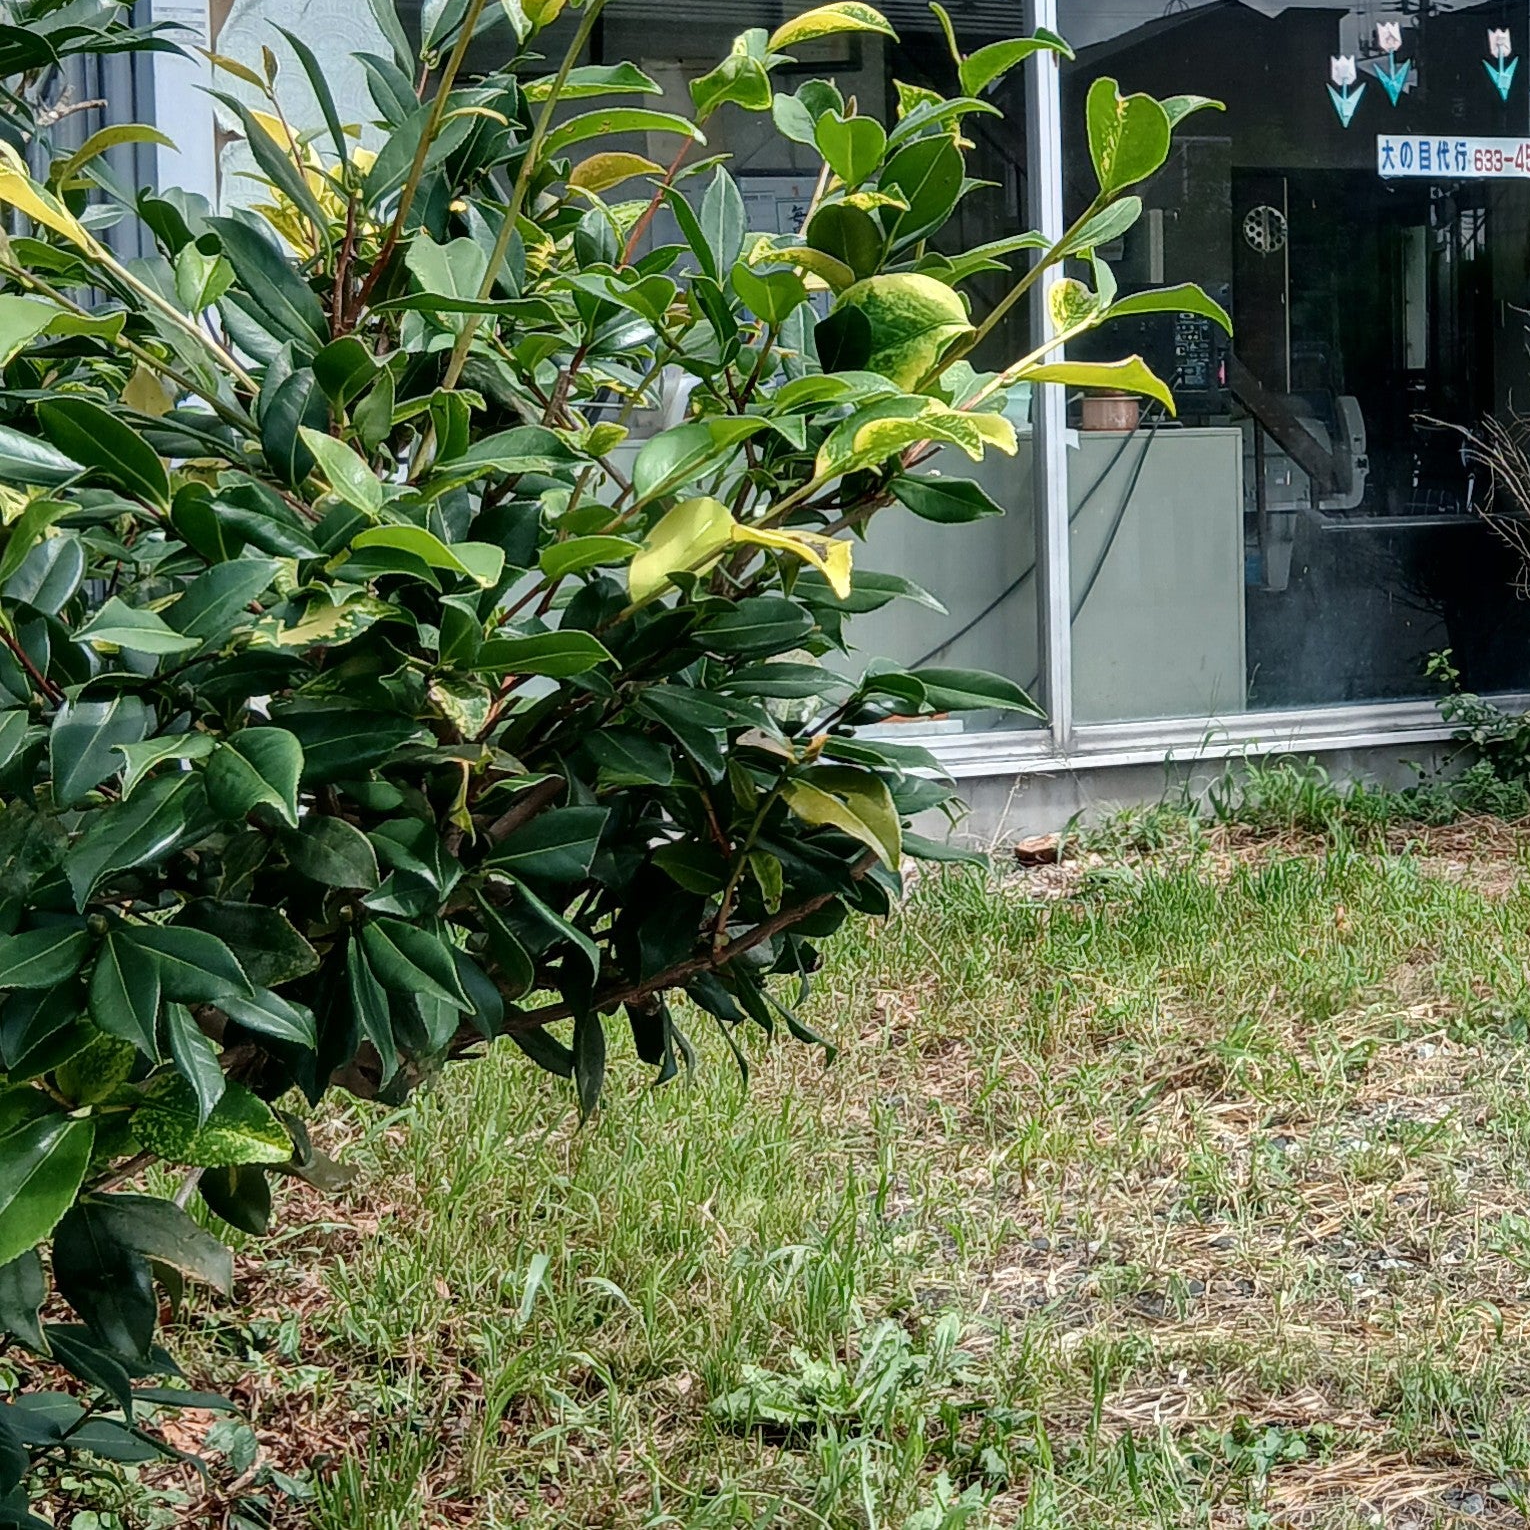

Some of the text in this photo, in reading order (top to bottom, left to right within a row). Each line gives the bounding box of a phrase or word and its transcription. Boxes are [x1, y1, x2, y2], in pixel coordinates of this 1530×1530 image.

[1382, 139, 1468, 171] 大の目代行
